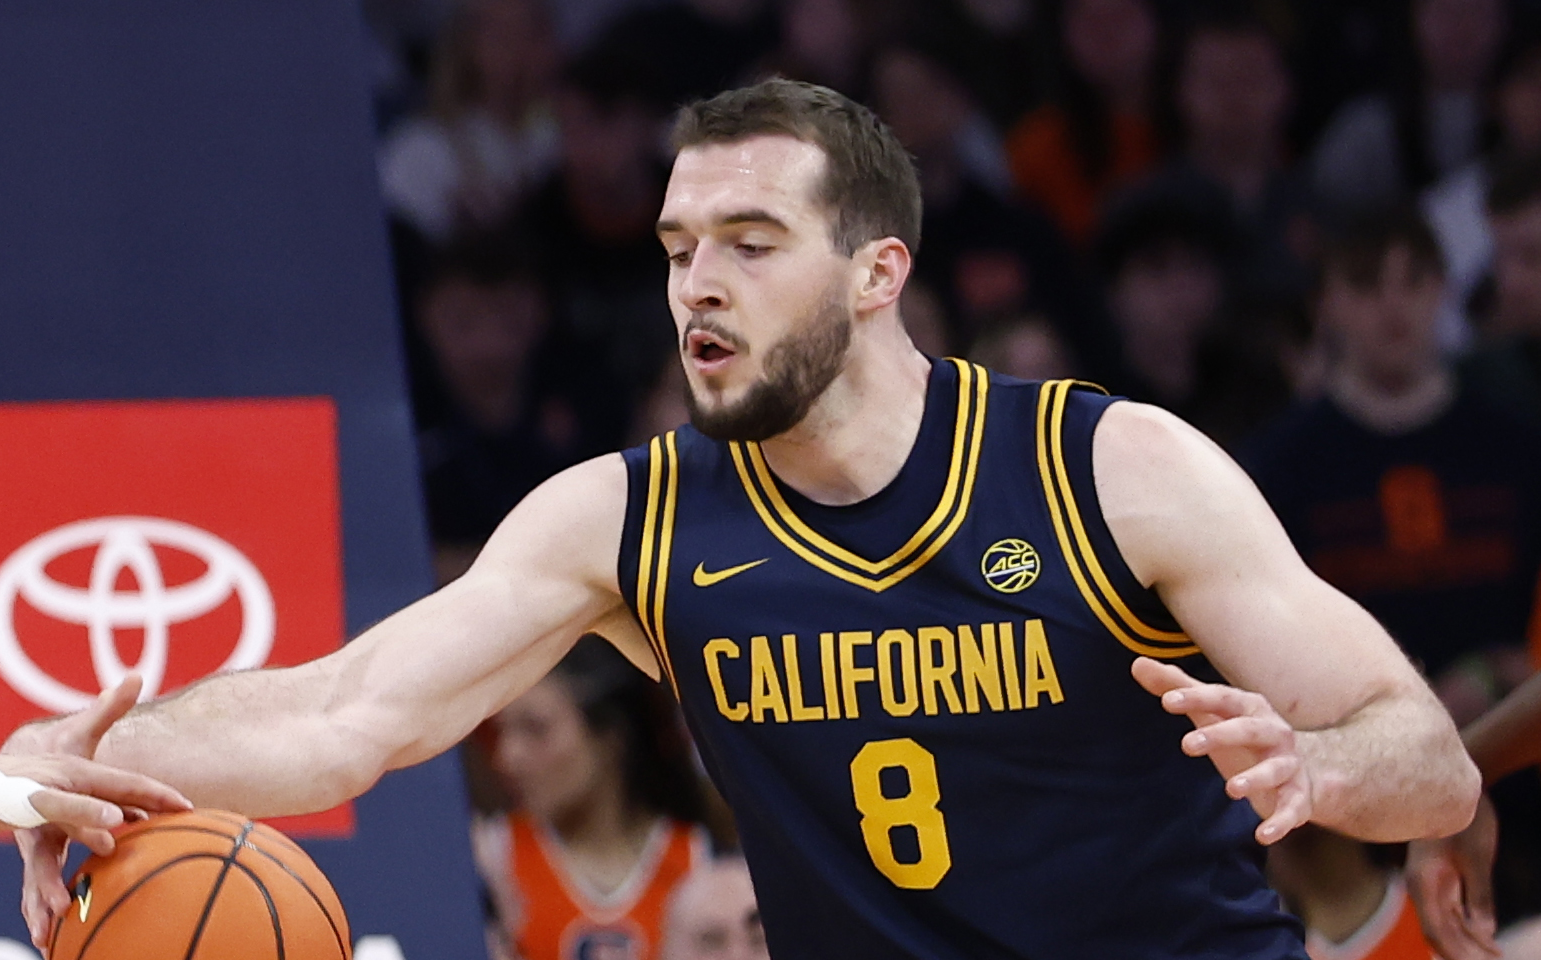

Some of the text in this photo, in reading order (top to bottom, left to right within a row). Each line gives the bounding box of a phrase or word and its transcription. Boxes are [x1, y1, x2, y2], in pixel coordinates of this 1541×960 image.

[988, 550, 1035, 573] ACC
[703, 618, 1065, 723] CALIFORNIA
[849, 737, 952, 890] 8
